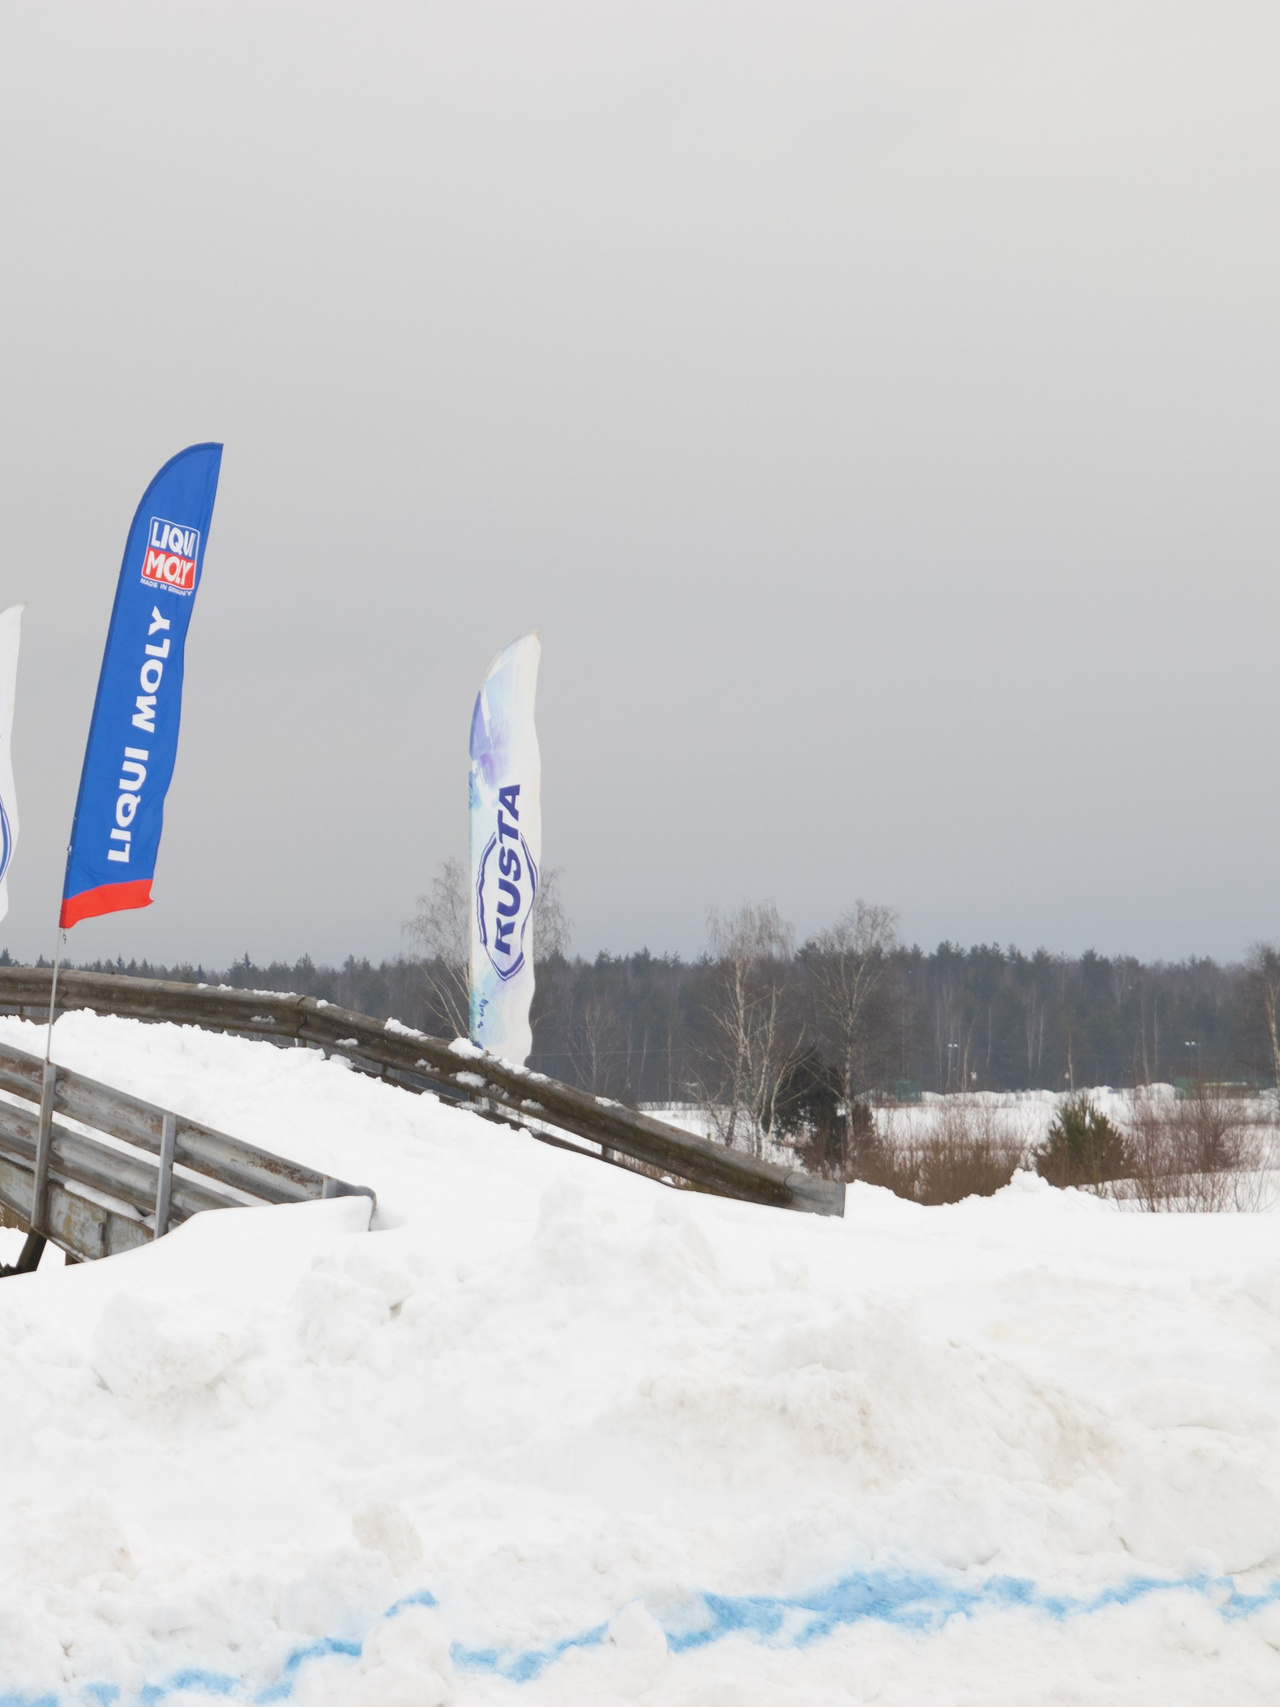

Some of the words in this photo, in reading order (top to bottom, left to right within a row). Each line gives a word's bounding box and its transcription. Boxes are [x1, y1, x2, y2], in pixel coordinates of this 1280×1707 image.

[145, 550, 194, 586] MOLY
[150, 521, 196, 557] LIQUI
[107, 746, 149, 863] LIQUI
[132, 605, 171, 733] MOLY
[494, 784, 521, 955] RUSTA
